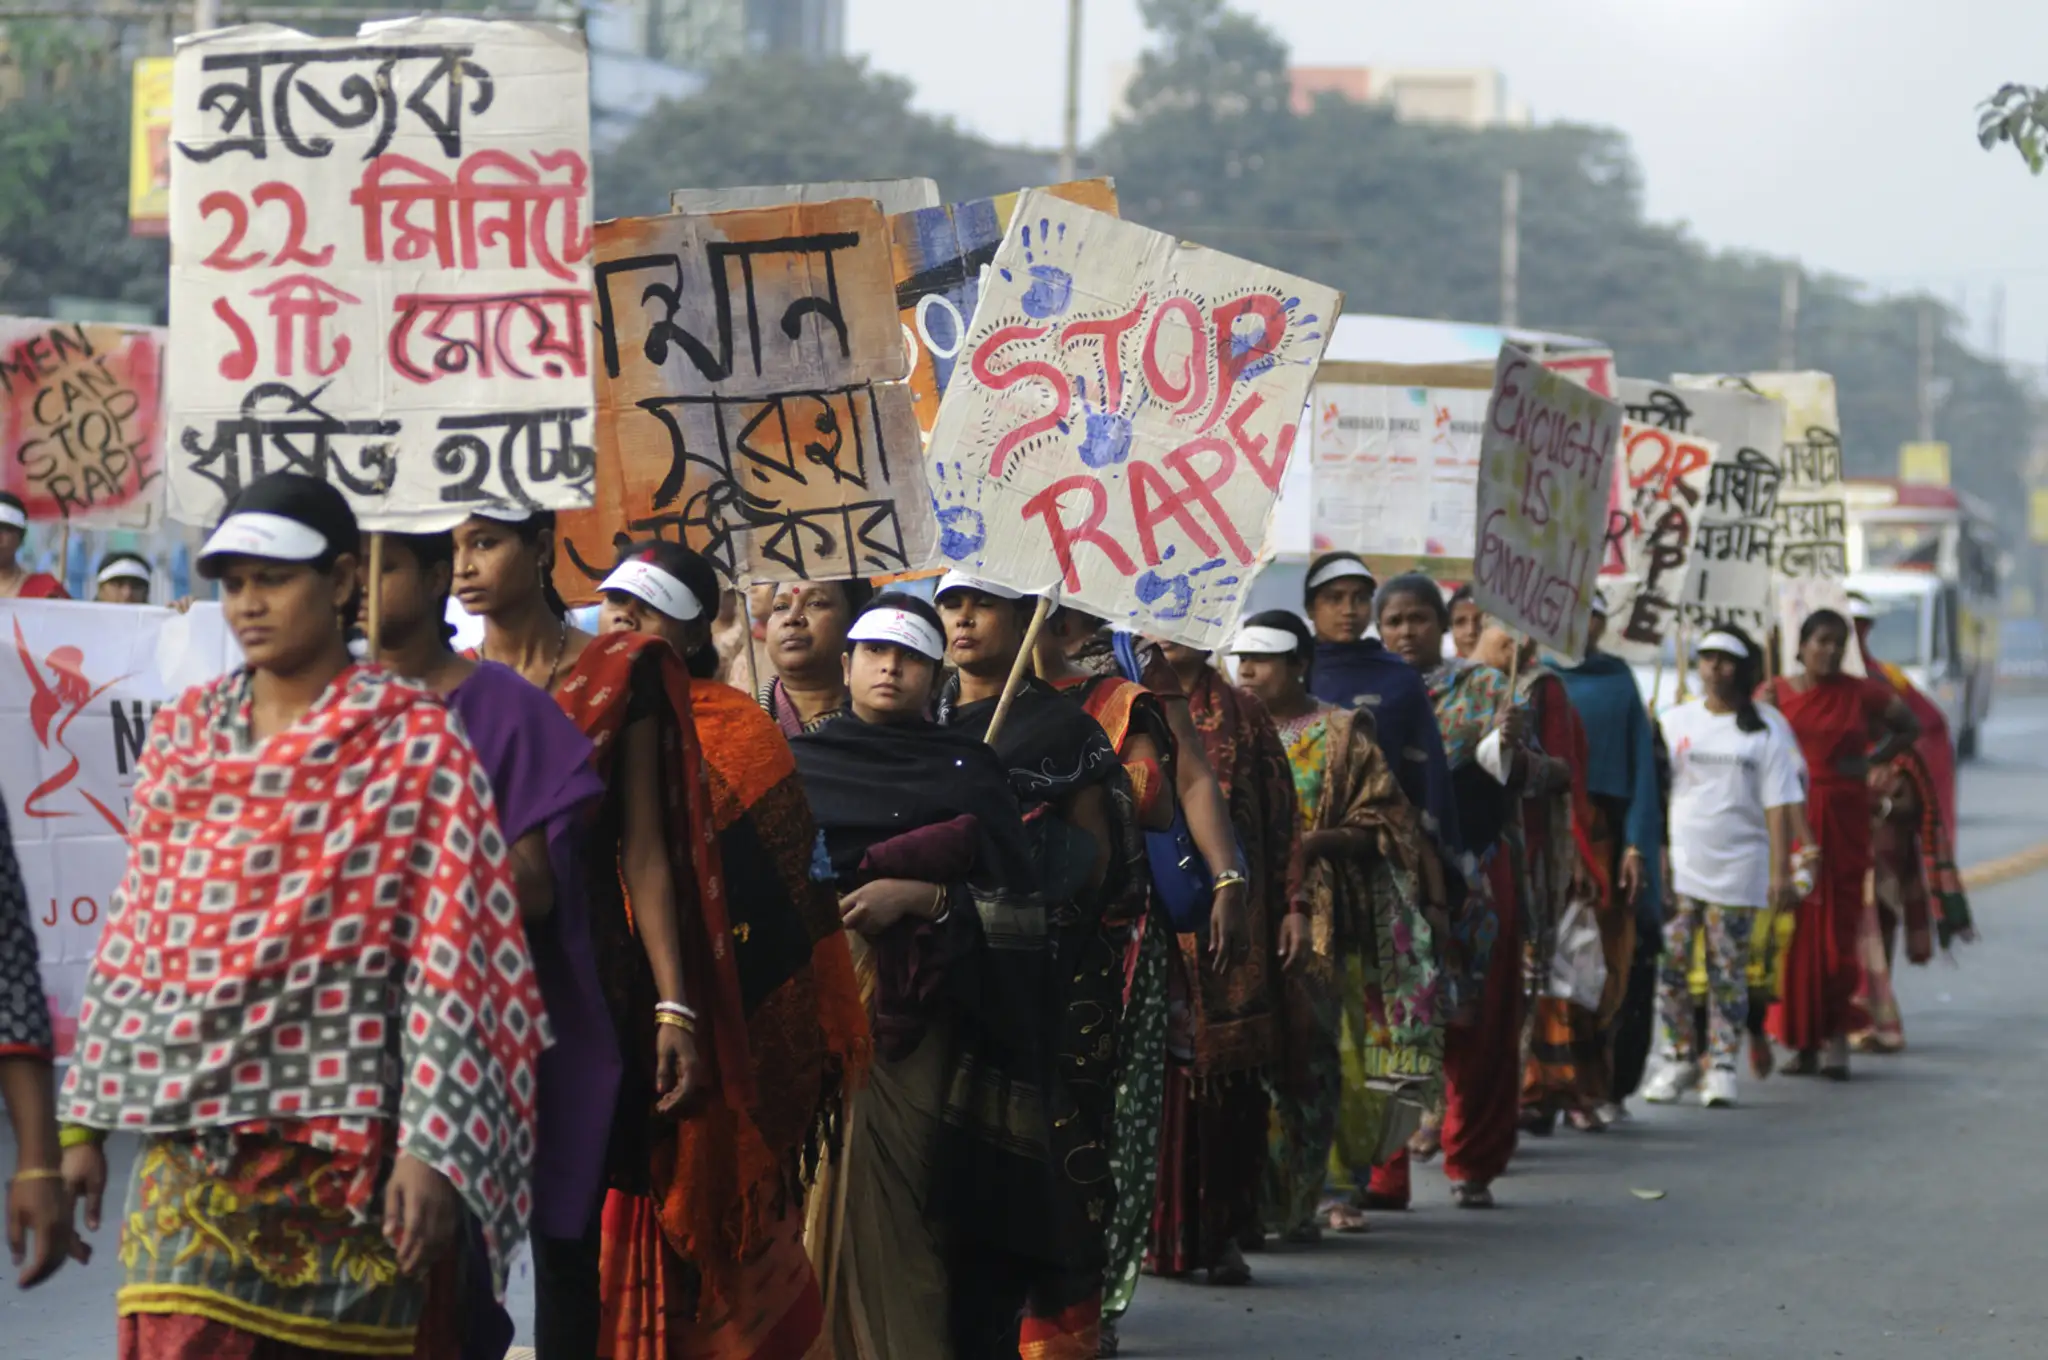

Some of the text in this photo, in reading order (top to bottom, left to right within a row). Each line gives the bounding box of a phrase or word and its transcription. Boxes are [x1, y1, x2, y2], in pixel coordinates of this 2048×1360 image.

[177, 46, 495, 161] প্রত্যেক
[198, 149, 594, 282] ২২ মিনিটে
[0, 323, 95, 396] MEN
[212, 274, 593, 384] ১টি মেয়ে
[970, 292, 1287, 478] STOP
[17, 390, 140, 482] STOP
[33, 355, 117, 426] CAN
[181, 380, 401, 498] ধর্ষিত
[1493, 361, 1612, 490] ENOUGH
[46, 433, 163, 518] RAPE
[1021, 391, 1298, 594] RAPE
[1520, 457, 1550, 526] IS
